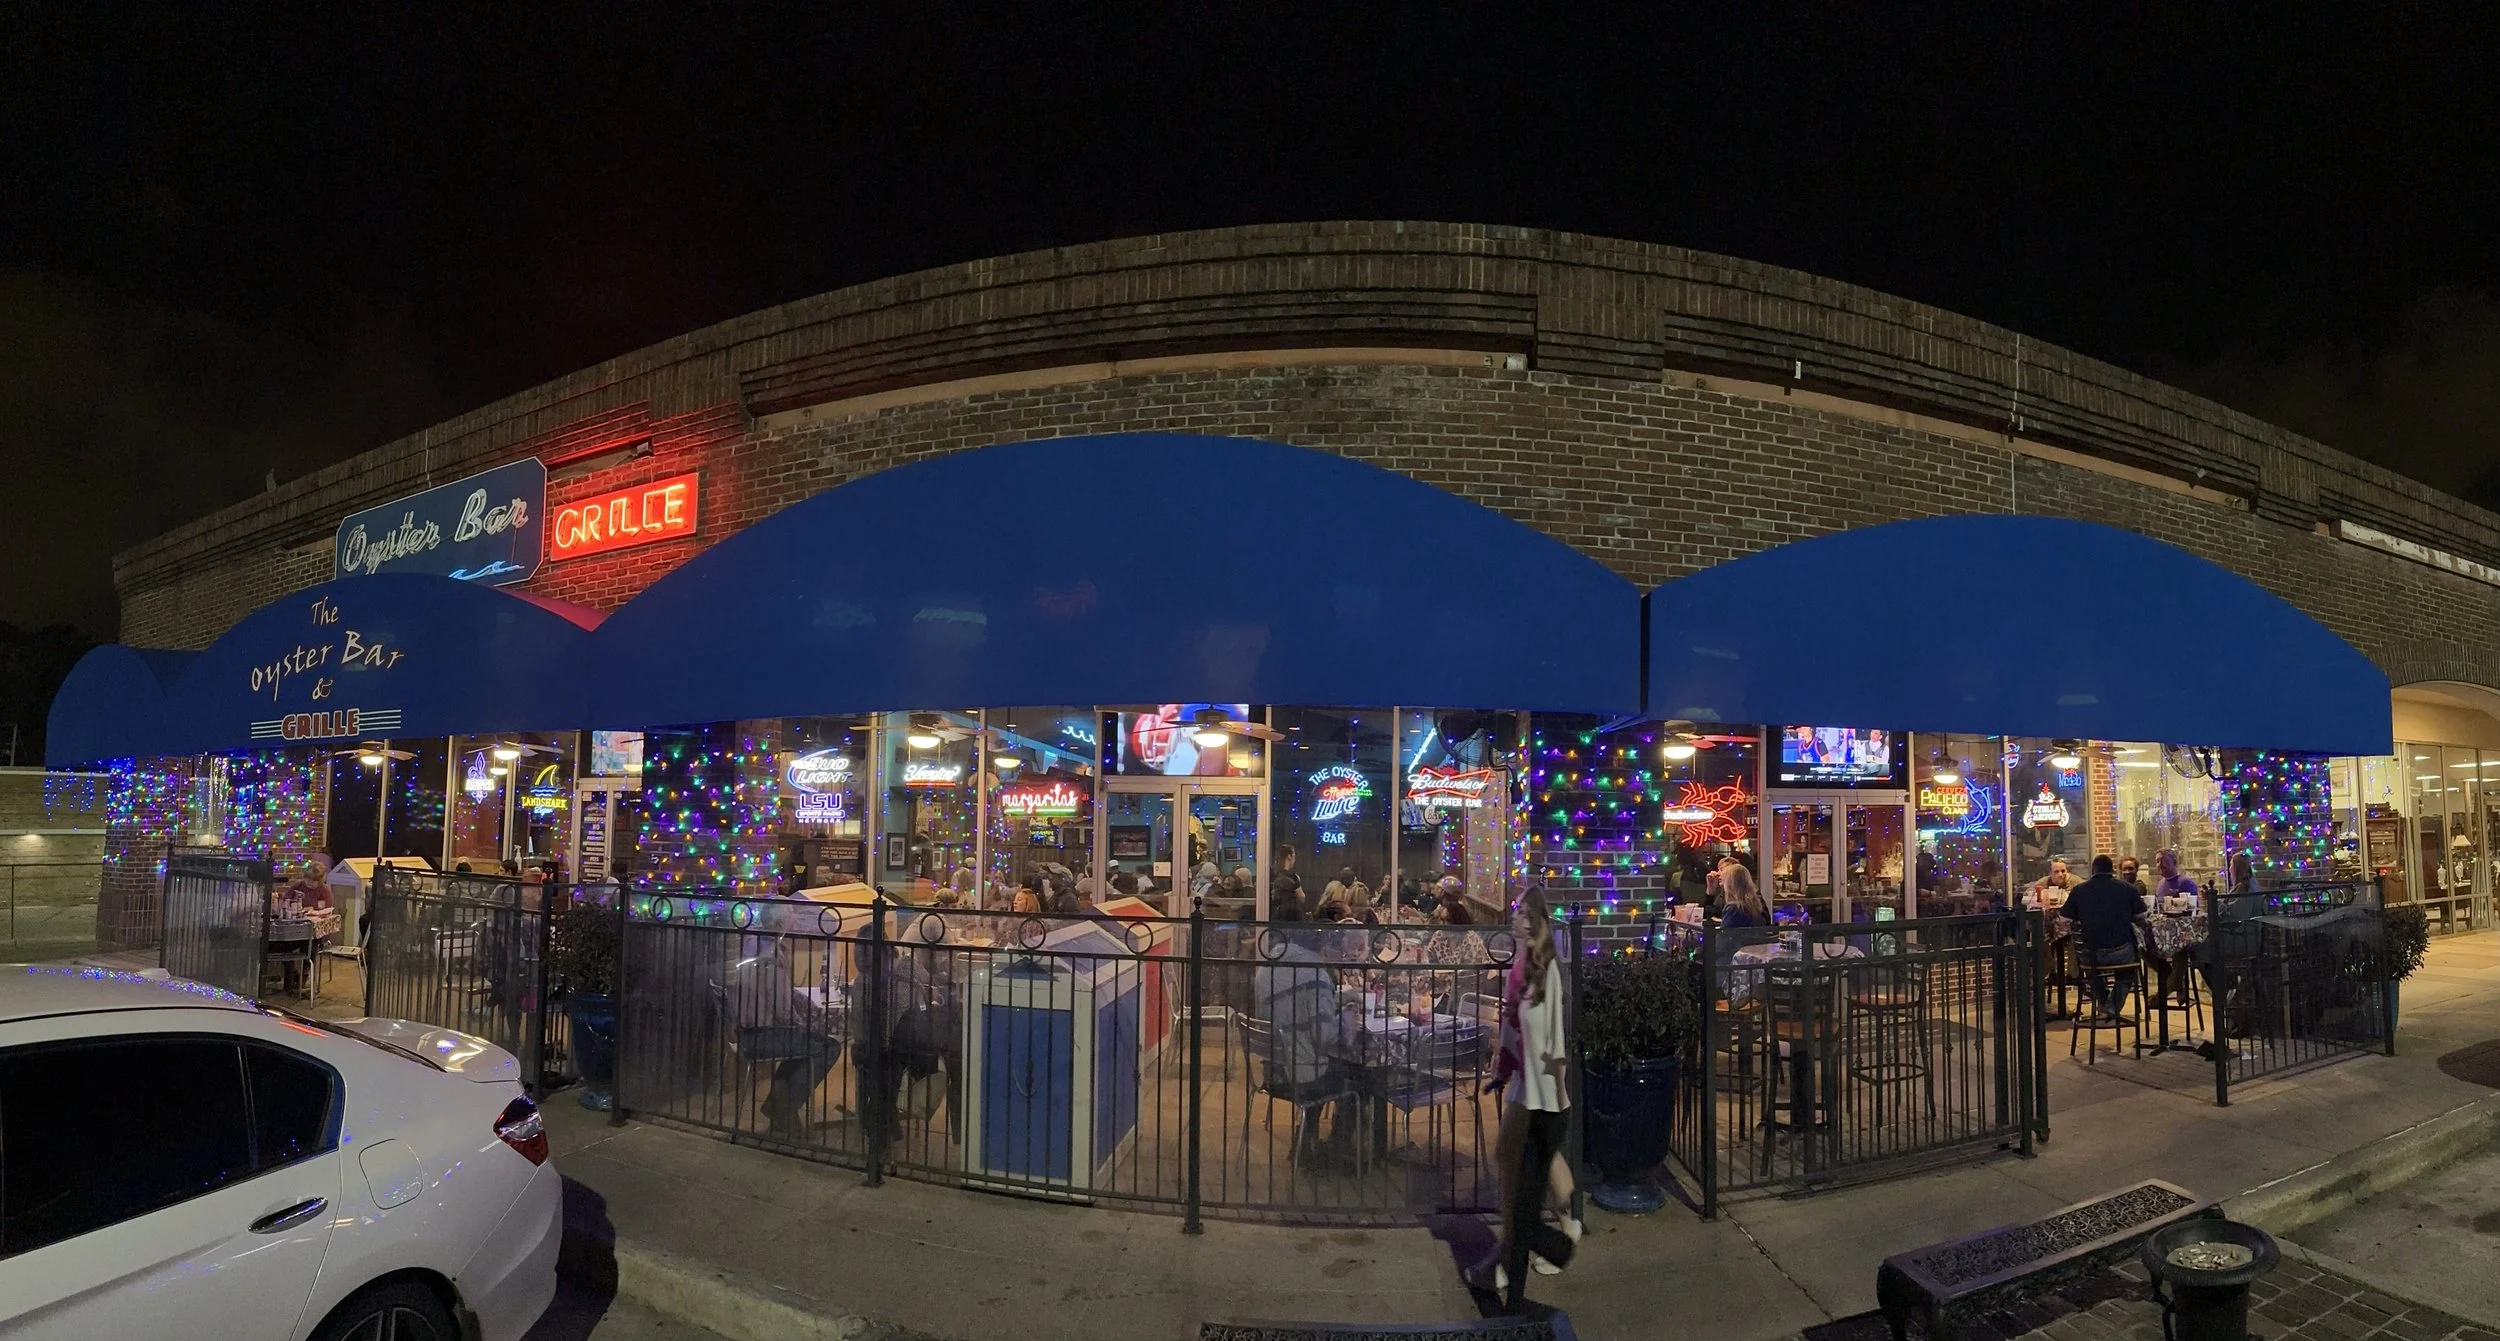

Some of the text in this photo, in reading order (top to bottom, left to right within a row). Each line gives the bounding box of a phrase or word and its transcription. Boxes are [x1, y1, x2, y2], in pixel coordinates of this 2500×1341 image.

[554, 483, 686, 549] GRILLE
[342, 488, 529, 575] Oyster Bar
[311, 596, 339, 626] The
[341, 630, 405, 669] Bar
[312, 677, 333, 700] &
[281, 707, 360, 740] GRILLE
[1308, 766, 1369, 790] THE OYSTER
[1407, 773, 1489, 790] Budweiser
[2059, 773, 2082, 788] Modelo
[1002, 784, 1079, 814] margaritas
[1936, 786, 1968, 794] CERVEZA
[521, 796, 568, 809] LANDSHARK
[800, 793, 841, 810] LSU
[1413, 796, 1483, 808] THE OYSTER BAR
[1942, 806, 1968, 815] CLARA
[1322, 832, 1346, 844] BAR
